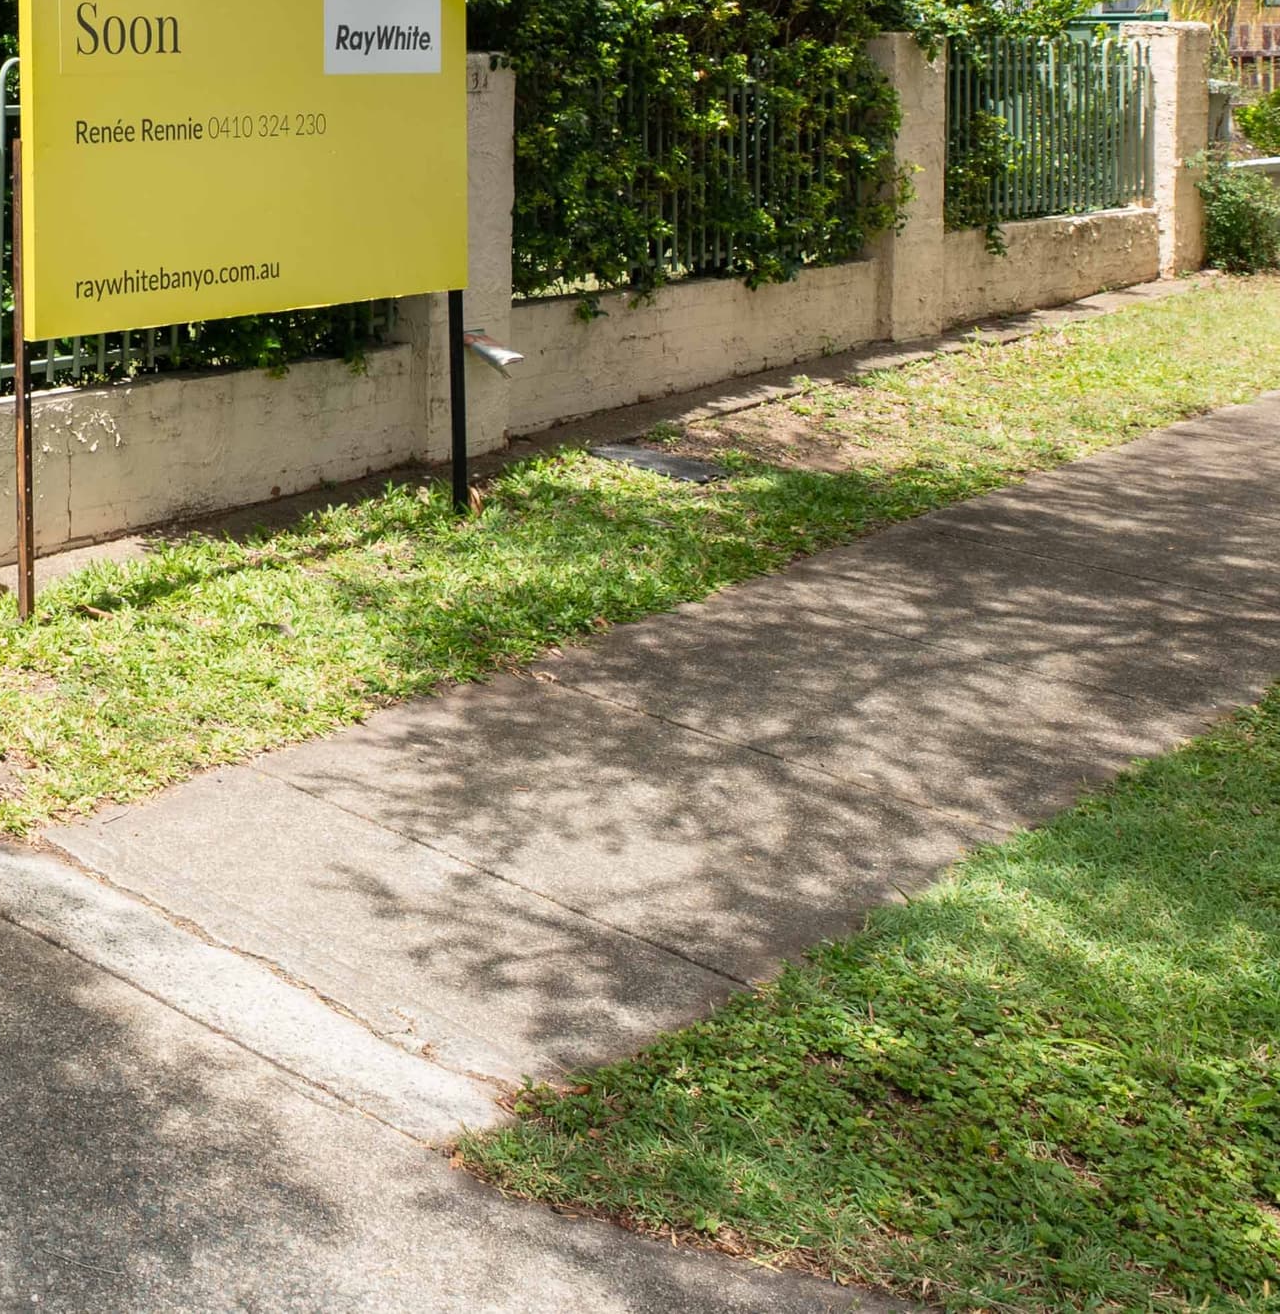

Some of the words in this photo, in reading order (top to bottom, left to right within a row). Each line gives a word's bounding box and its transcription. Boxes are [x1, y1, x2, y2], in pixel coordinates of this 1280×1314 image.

[76, 1, 182, 56] Soon
[335, 24, 432, 56] RayWhite
[75, 118, 135, 145] Renée
[141, 117, 204, 143] Rennie
[207, 115, 253, 140] 0410
[258, 114, 291, 138] 324
[295, 113, 327, 136] 230
[75, 261, 281, 302] raywhitebanyo.com.au
